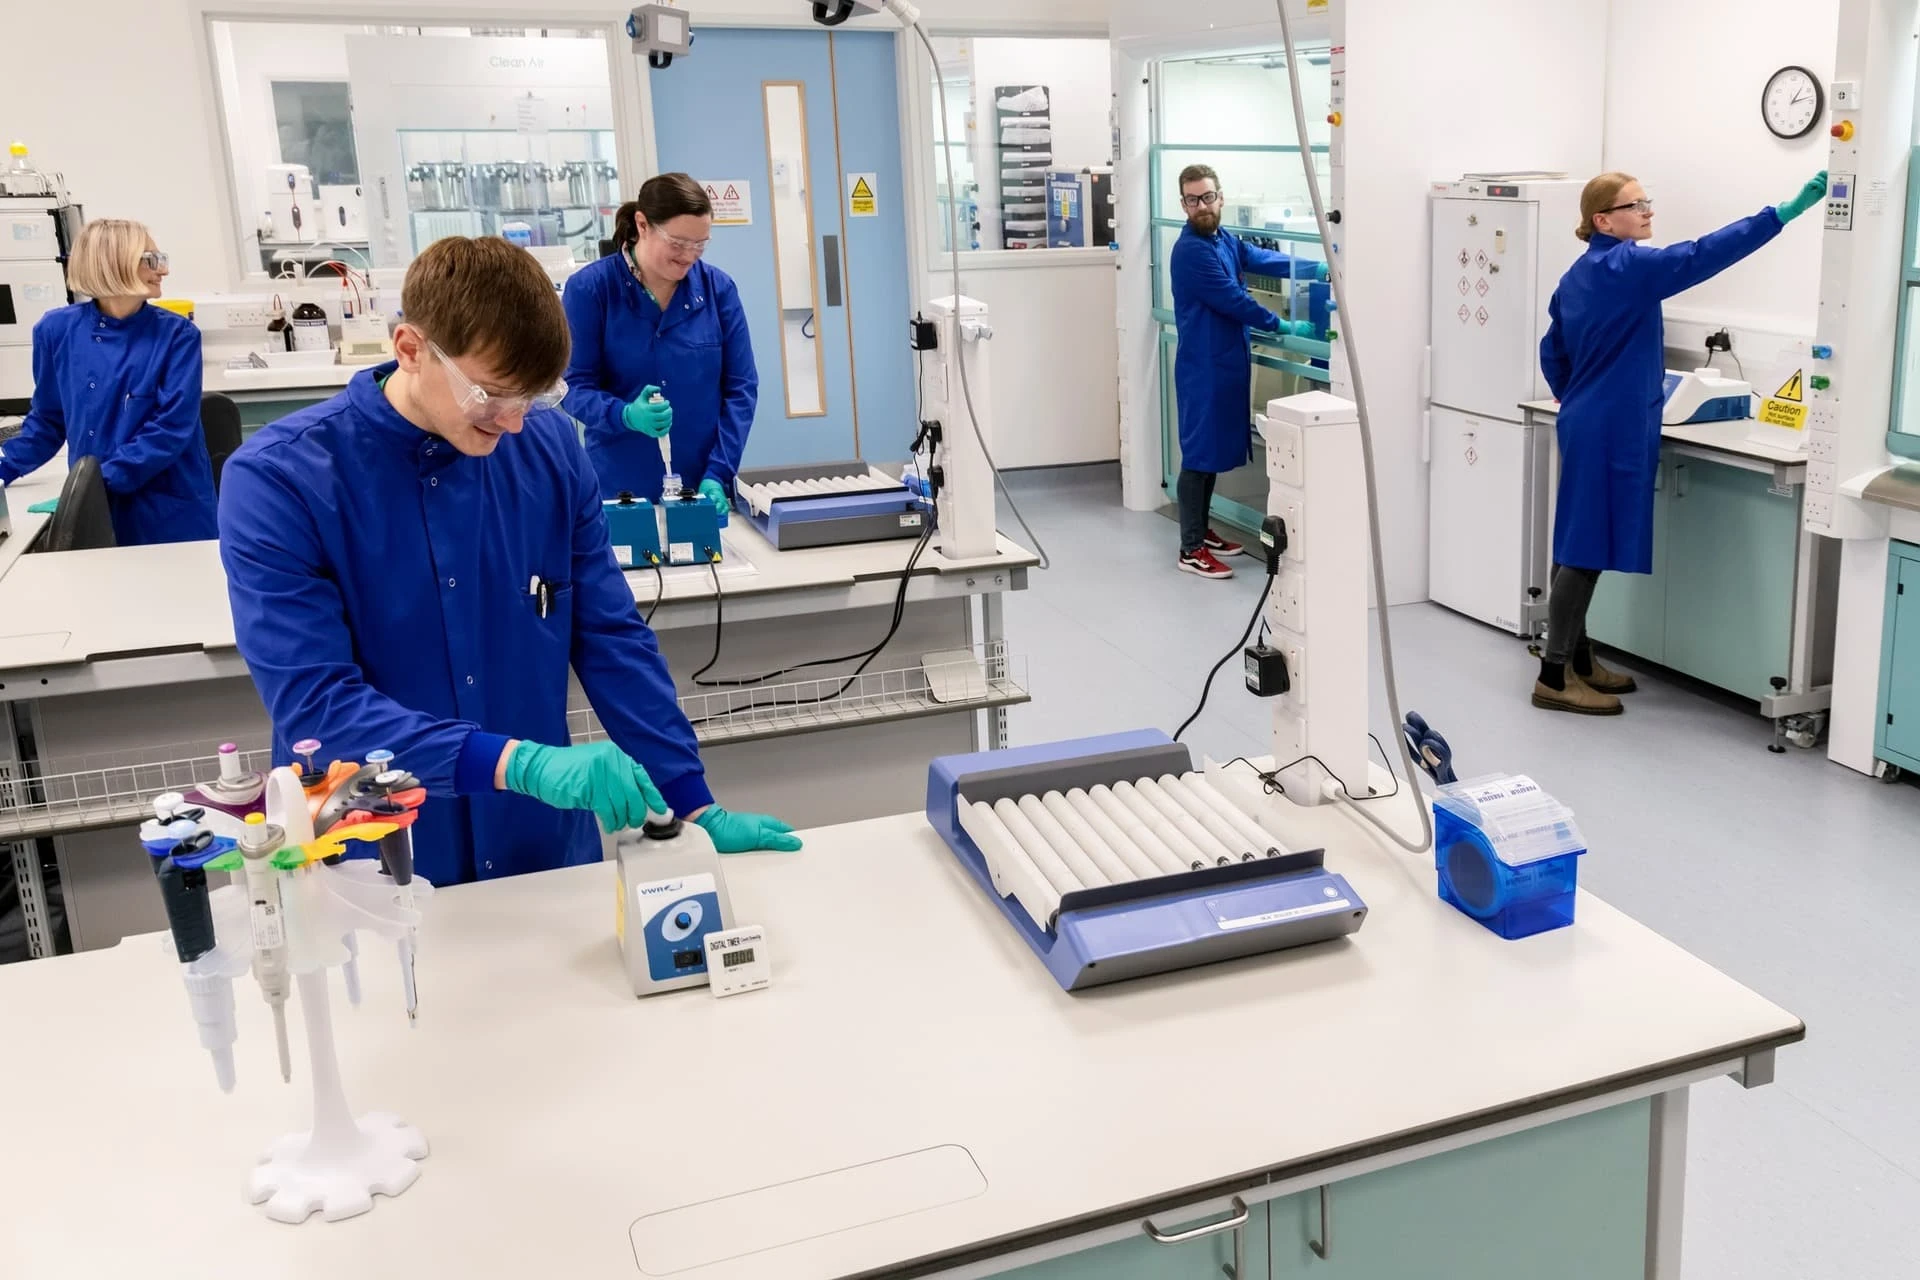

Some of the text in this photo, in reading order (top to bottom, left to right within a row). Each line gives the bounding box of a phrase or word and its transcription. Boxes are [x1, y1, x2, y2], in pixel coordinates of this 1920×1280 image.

[489, 56, 544, 69] Clean Air
[1767, 401, 1801, 416] Caution
[709, 940, 727, 952] DIGITAL
[727, 937, 741, 947] TIMER
